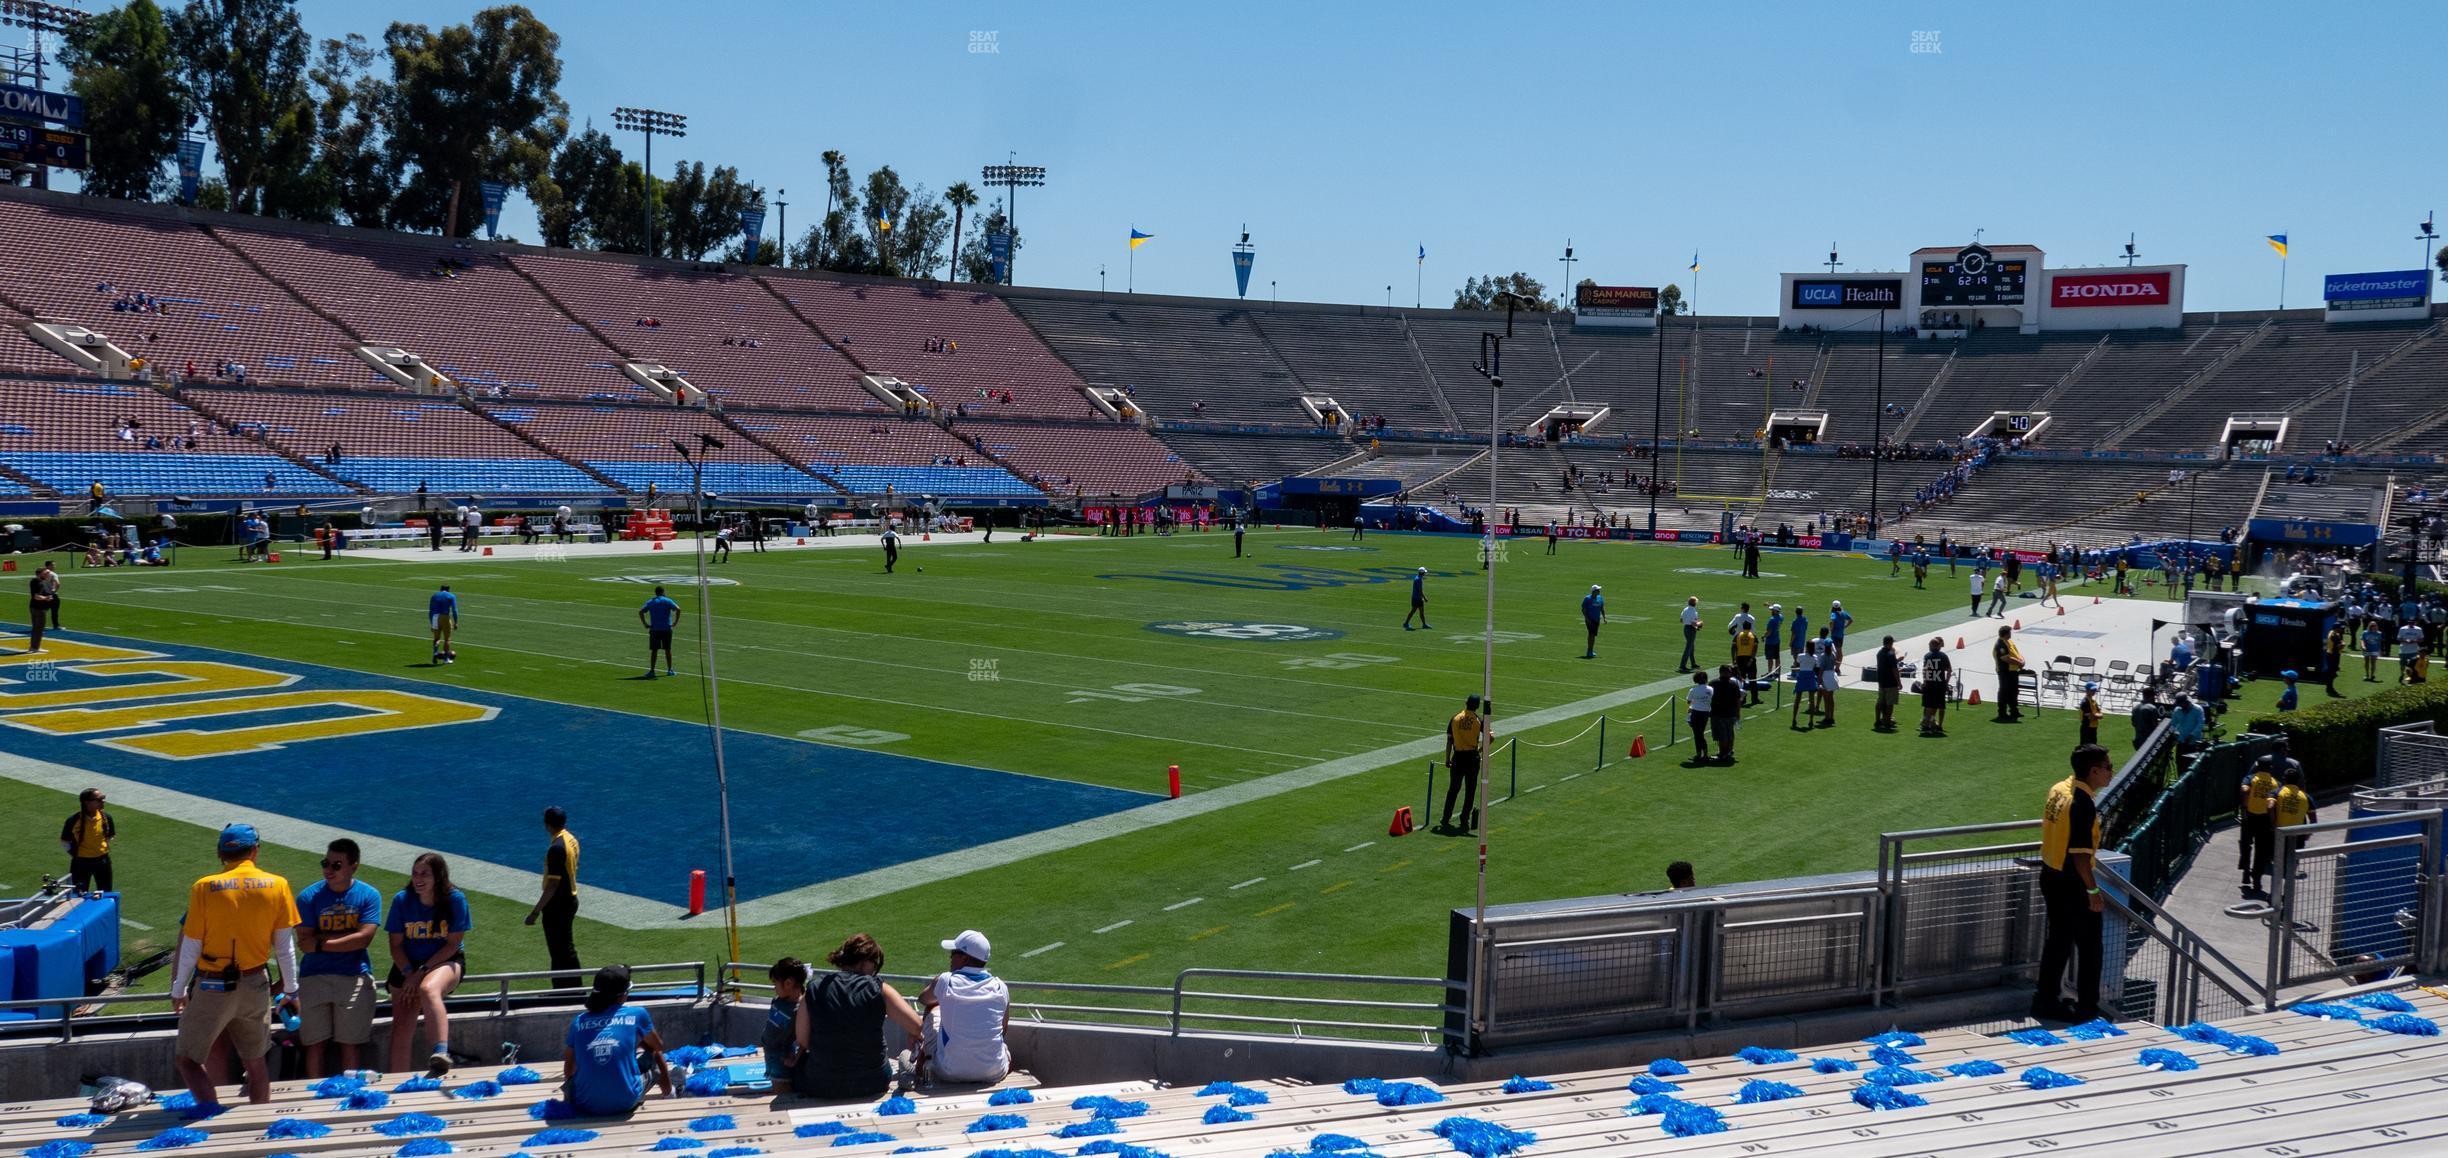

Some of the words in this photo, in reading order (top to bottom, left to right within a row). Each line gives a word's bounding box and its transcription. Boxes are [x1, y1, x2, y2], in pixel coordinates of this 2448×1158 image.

[56, 146, 65, 158] 0
[1948, 265, 1954, 273] 0
[1998, 264, 2003, 272] 0
[2018, 275, 2024, 283] 3
[2060, 281, 2160, 299] HONDA
[2327, 278, 2420, 293] ticketmaster
[1592, 290, 1613, 298] SAN
[1615, 291, 1656, 299] MANUEL
[1804, 289, 1837, 300] UCLA
[1846, 287, 1894, 301] Health
[2010, 416, 2029, 430] 40
[1567, 528, 1591, 538] TCL
[210, 879, 239, 892] GAME
[243, 878, 275, 889] STAFF
[319, 913, 361, 931] DEN
[576, 1016, 624, 1032] WESCOM
[595, 1045, 611, 1057] DEN
[2149, 1089, 2175, 1098] 10
[2342, 1091, 2371, 1100] 10
[2053, 1100, 2081, 1110] 11
[2249, 1105, 2278, 1114] 11
[1586, 1110, 1609, 1118] 13
[1805, 1107, 1831, 1116] 12
[1386, 1116, 1408, 1124] 14
[1955, 1113, 1984, 1123] 12
[1293, 1125, 1317, 1133] 15
[2147, 1120, 2179, 1130] 12
[1385, 1133, 1411, 1142] 15
[1603, 1132, 1630, 1142] 14
[1852, 1128, 1880, 1137] 13
[2373, 1127, 2408, 1138] 12
[1188, 1136, 1212, 1145] 16
[2028, 1138, 2059, 1148] 13
[1740, 1142, 1769, 1153] 14
[2265, 1145, 2301, 1156] 13
